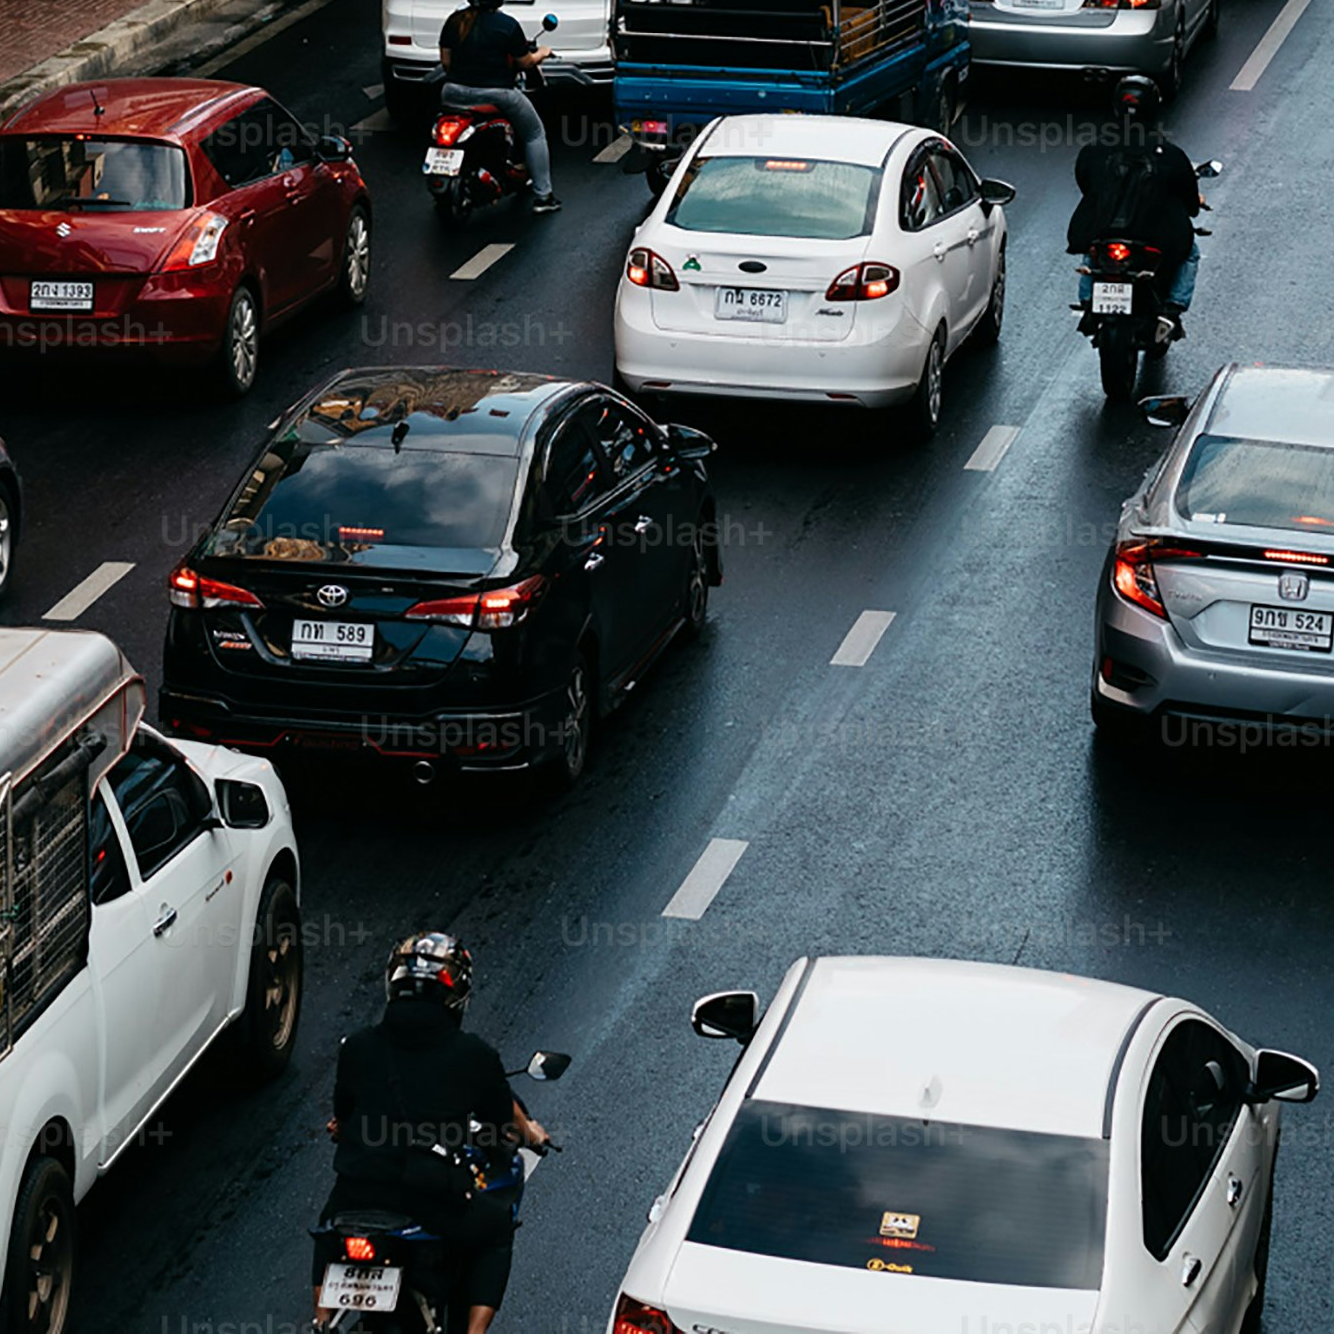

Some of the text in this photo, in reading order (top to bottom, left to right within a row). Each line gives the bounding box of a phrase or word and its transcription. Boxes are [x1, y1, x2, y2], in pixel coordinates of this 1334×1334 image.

[749, 293, 782, 307] 6672
[1295, 614, 1324, 631] 524
[336, 624, 366, 642] 589
[338, 1293, 377, 1308] 696
